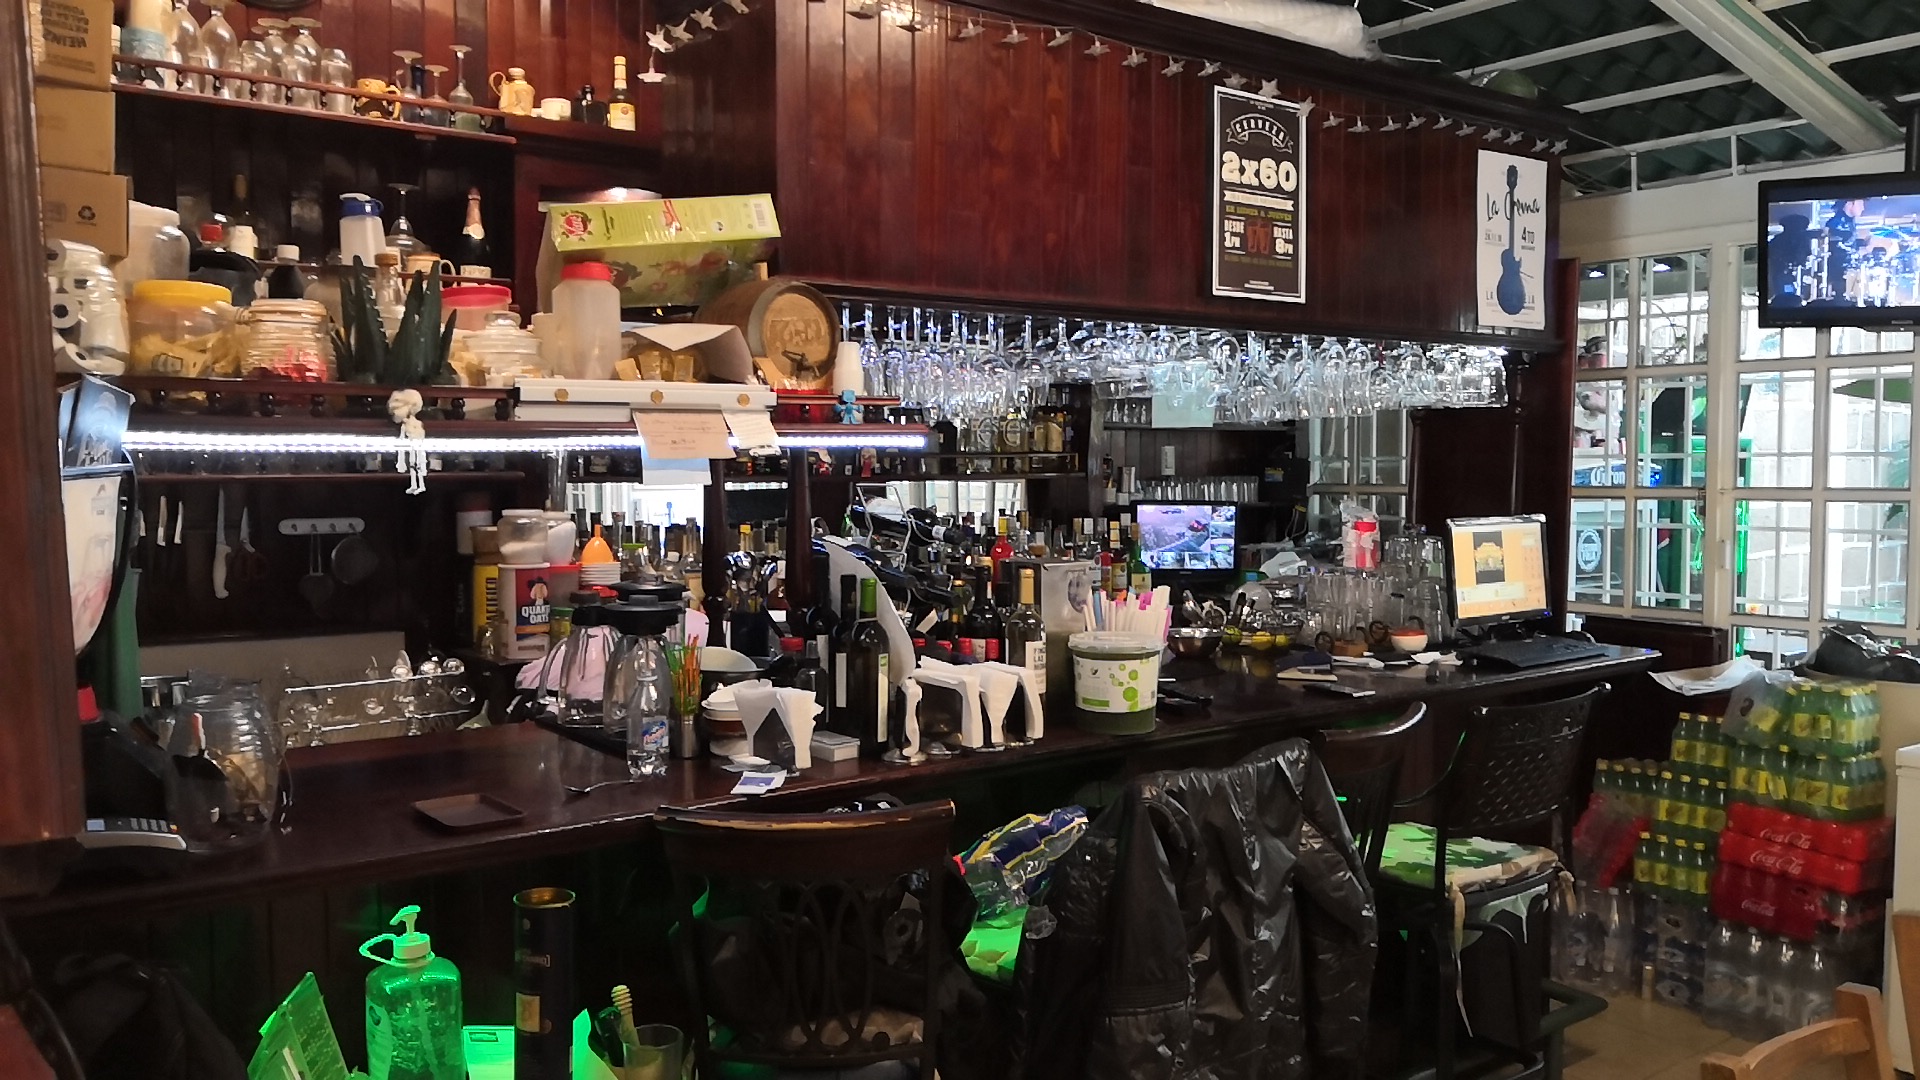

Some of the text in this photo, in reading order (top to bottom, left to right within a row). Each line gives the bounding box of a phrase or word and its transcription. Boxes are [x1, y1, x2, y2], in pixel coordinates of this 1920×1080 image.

[1235, 119, 1285, 141] CERVEZA
[1505, 191, 1540, 221] Cema
[1224, 219, 1245, 233] DESDE
[1273, 226, 1293, 240] HASTA
[485, 577, 498, 624] ACIFICO
[522, 605, 550, 618] QUAK
